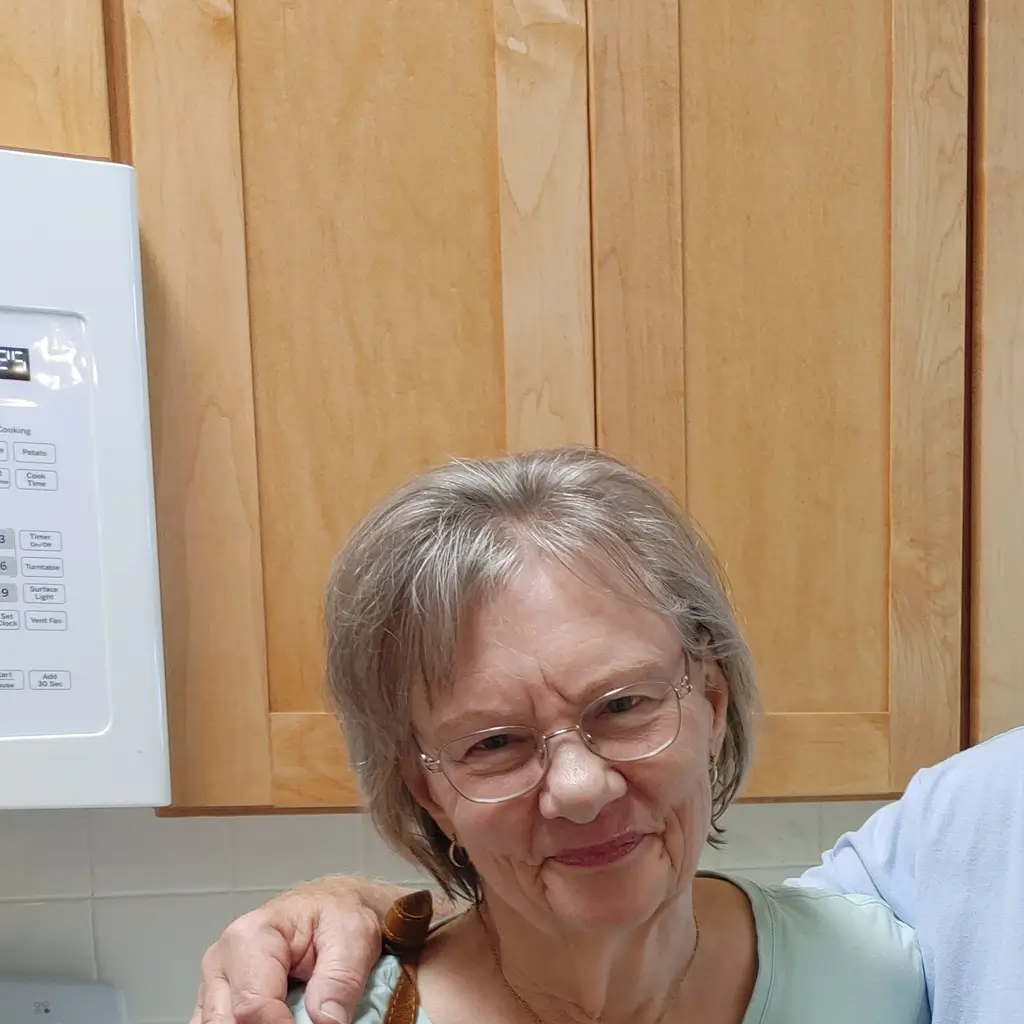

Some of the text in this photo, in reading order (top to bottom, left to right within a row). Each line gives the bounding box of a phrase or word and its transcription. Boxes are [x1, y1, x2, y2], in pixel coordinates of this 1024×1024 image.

[22, 448, 47, 456] Potato
[25, 563, 61, 571] Turntable
[1, 588, 9, 598] 9
[35, 593, 54, 601] Light
[37, 680, 63, 688] 30 Sec
